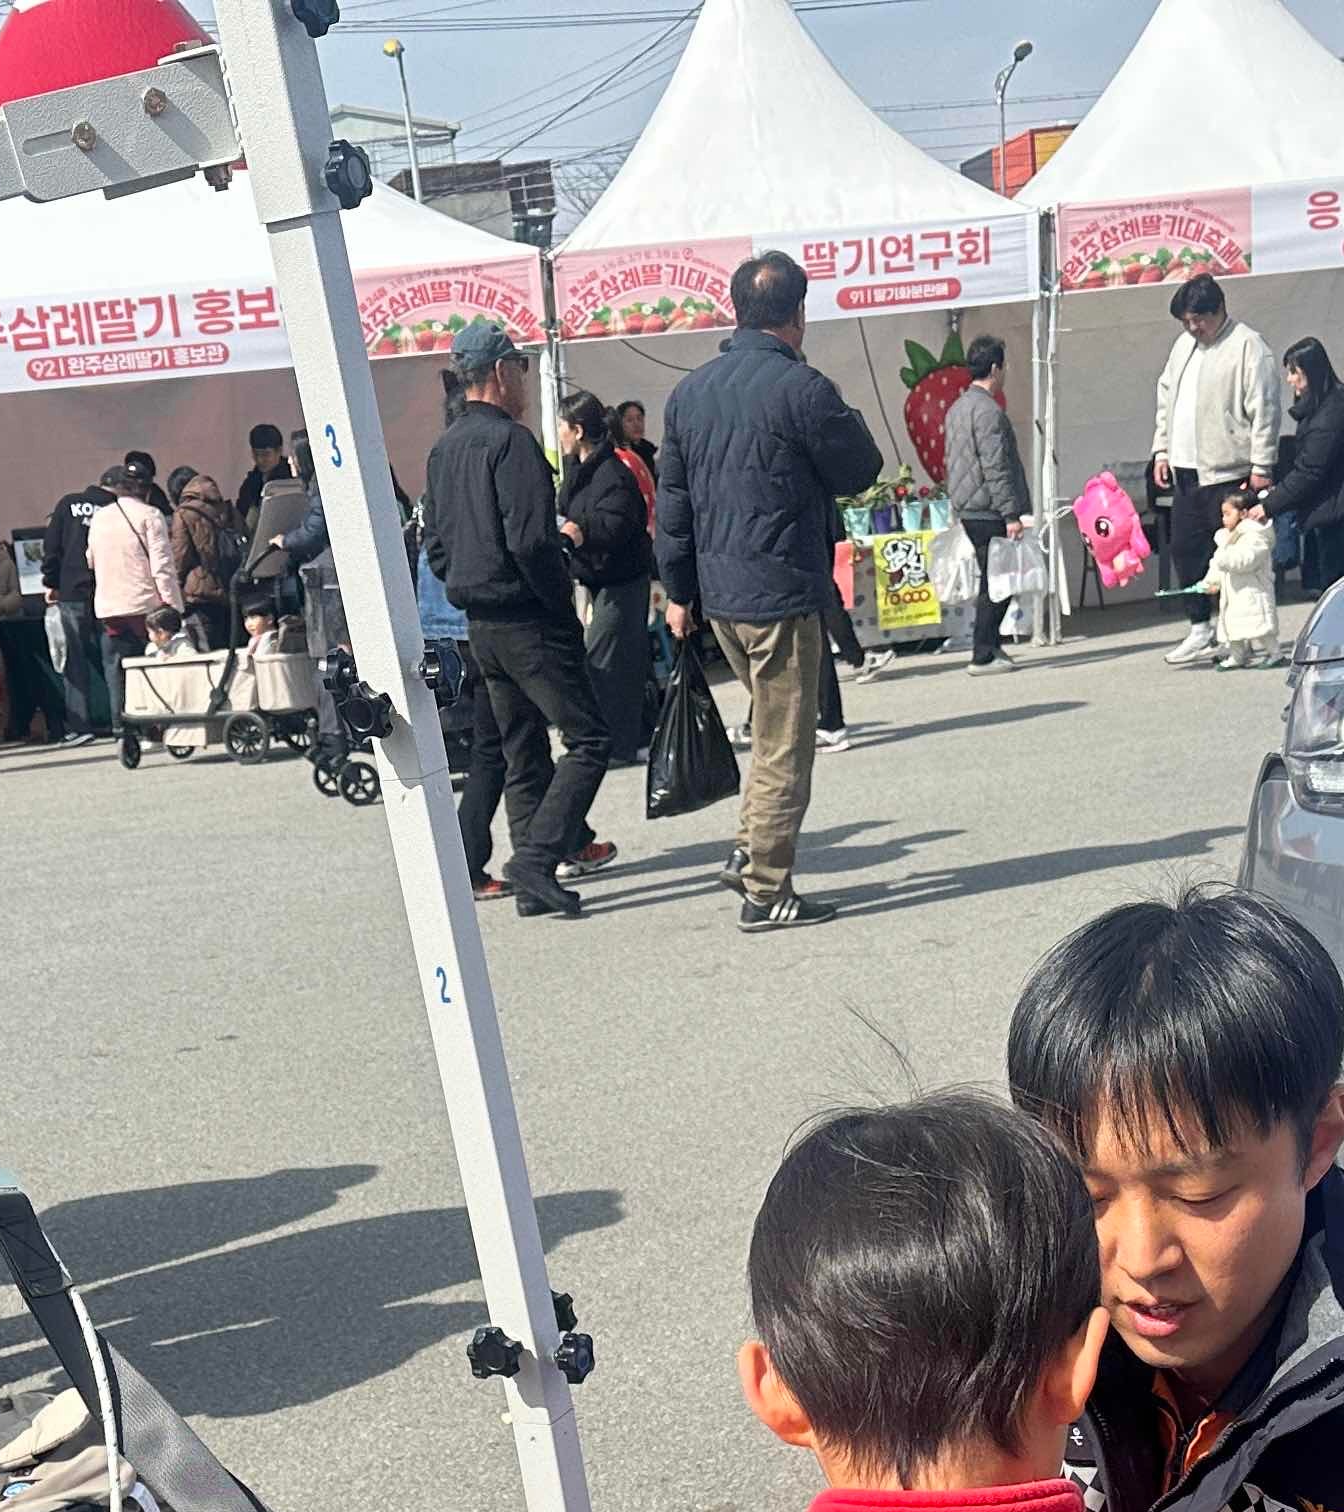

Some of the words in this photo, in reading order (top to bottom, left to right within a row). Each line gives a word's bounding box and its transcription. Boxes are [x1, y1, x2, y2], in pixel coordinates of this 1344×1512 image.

[802, 226, 990, 280] 딸기연구회
[324, 423, 344, 469] 3
[435, 966, 452, 1004] 2
